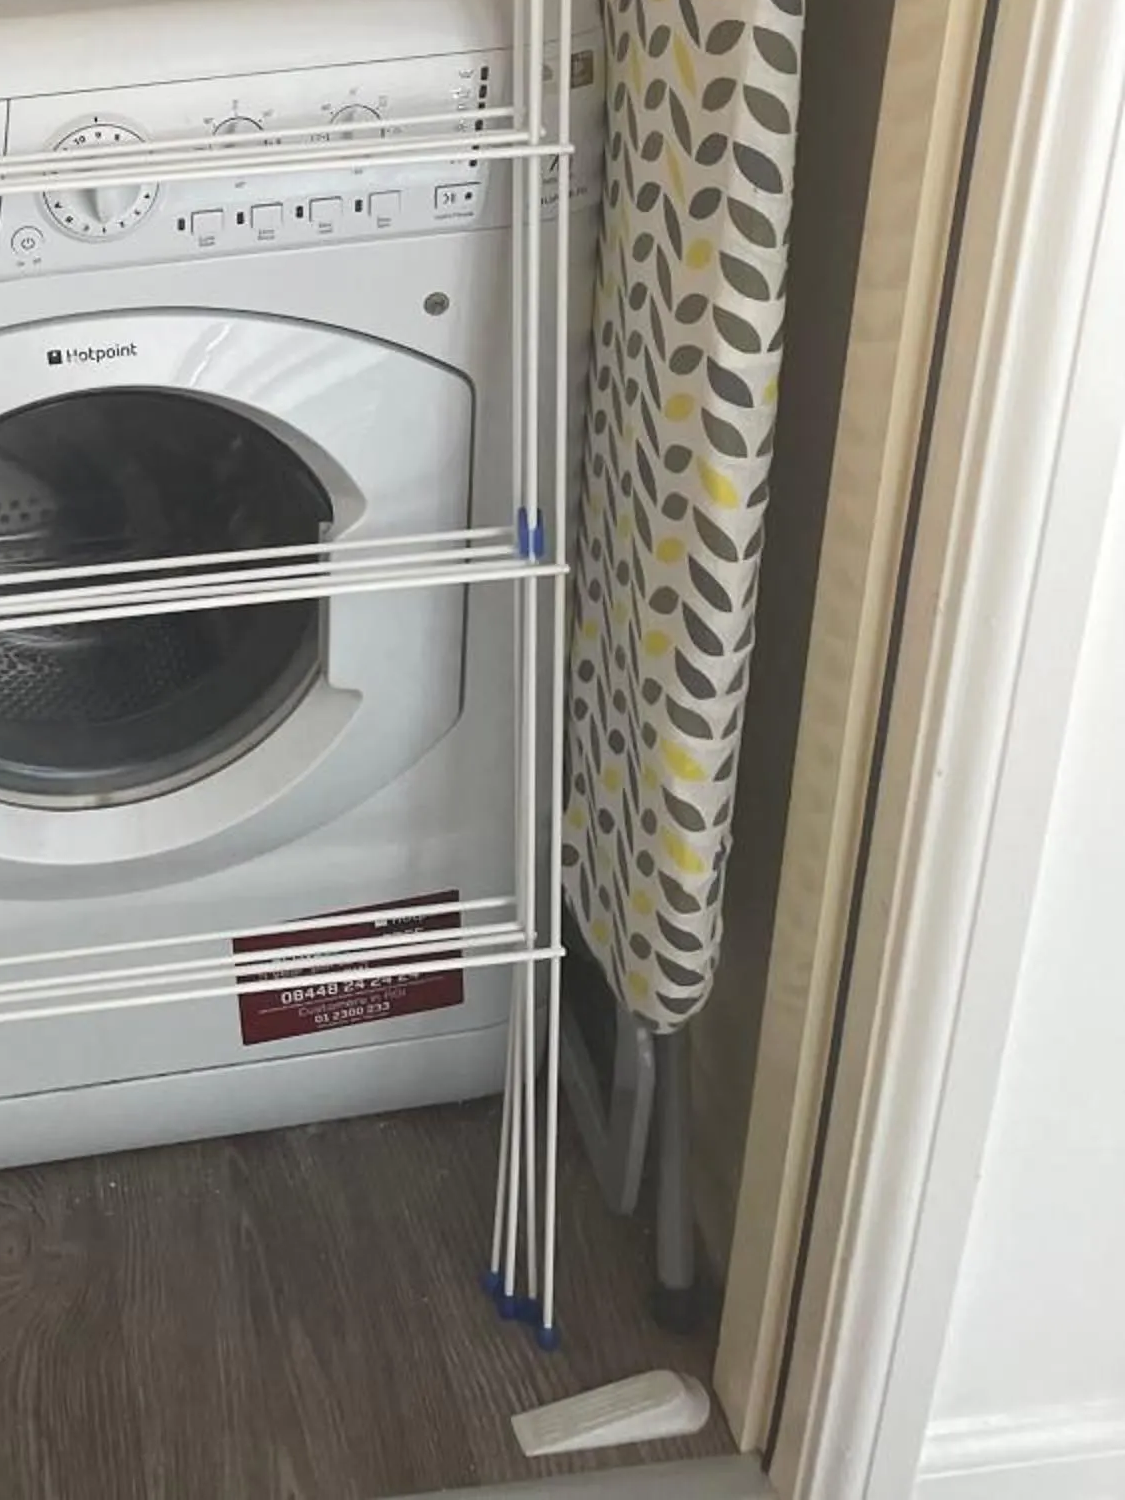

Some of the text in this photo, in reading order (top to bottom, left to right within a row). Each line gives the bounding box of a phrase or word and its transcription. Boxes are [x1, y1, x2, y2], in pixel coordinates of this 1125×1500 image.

[74, 134, 87, 145] 10
[66, 343, 138, 363] Hotpoint
[280, 983, 339, 1005] 08448
[343, 978, 366, 993] 24
[314, 1012, 330, 1024] 01
[332, 1006, 365, 1021] 2300
